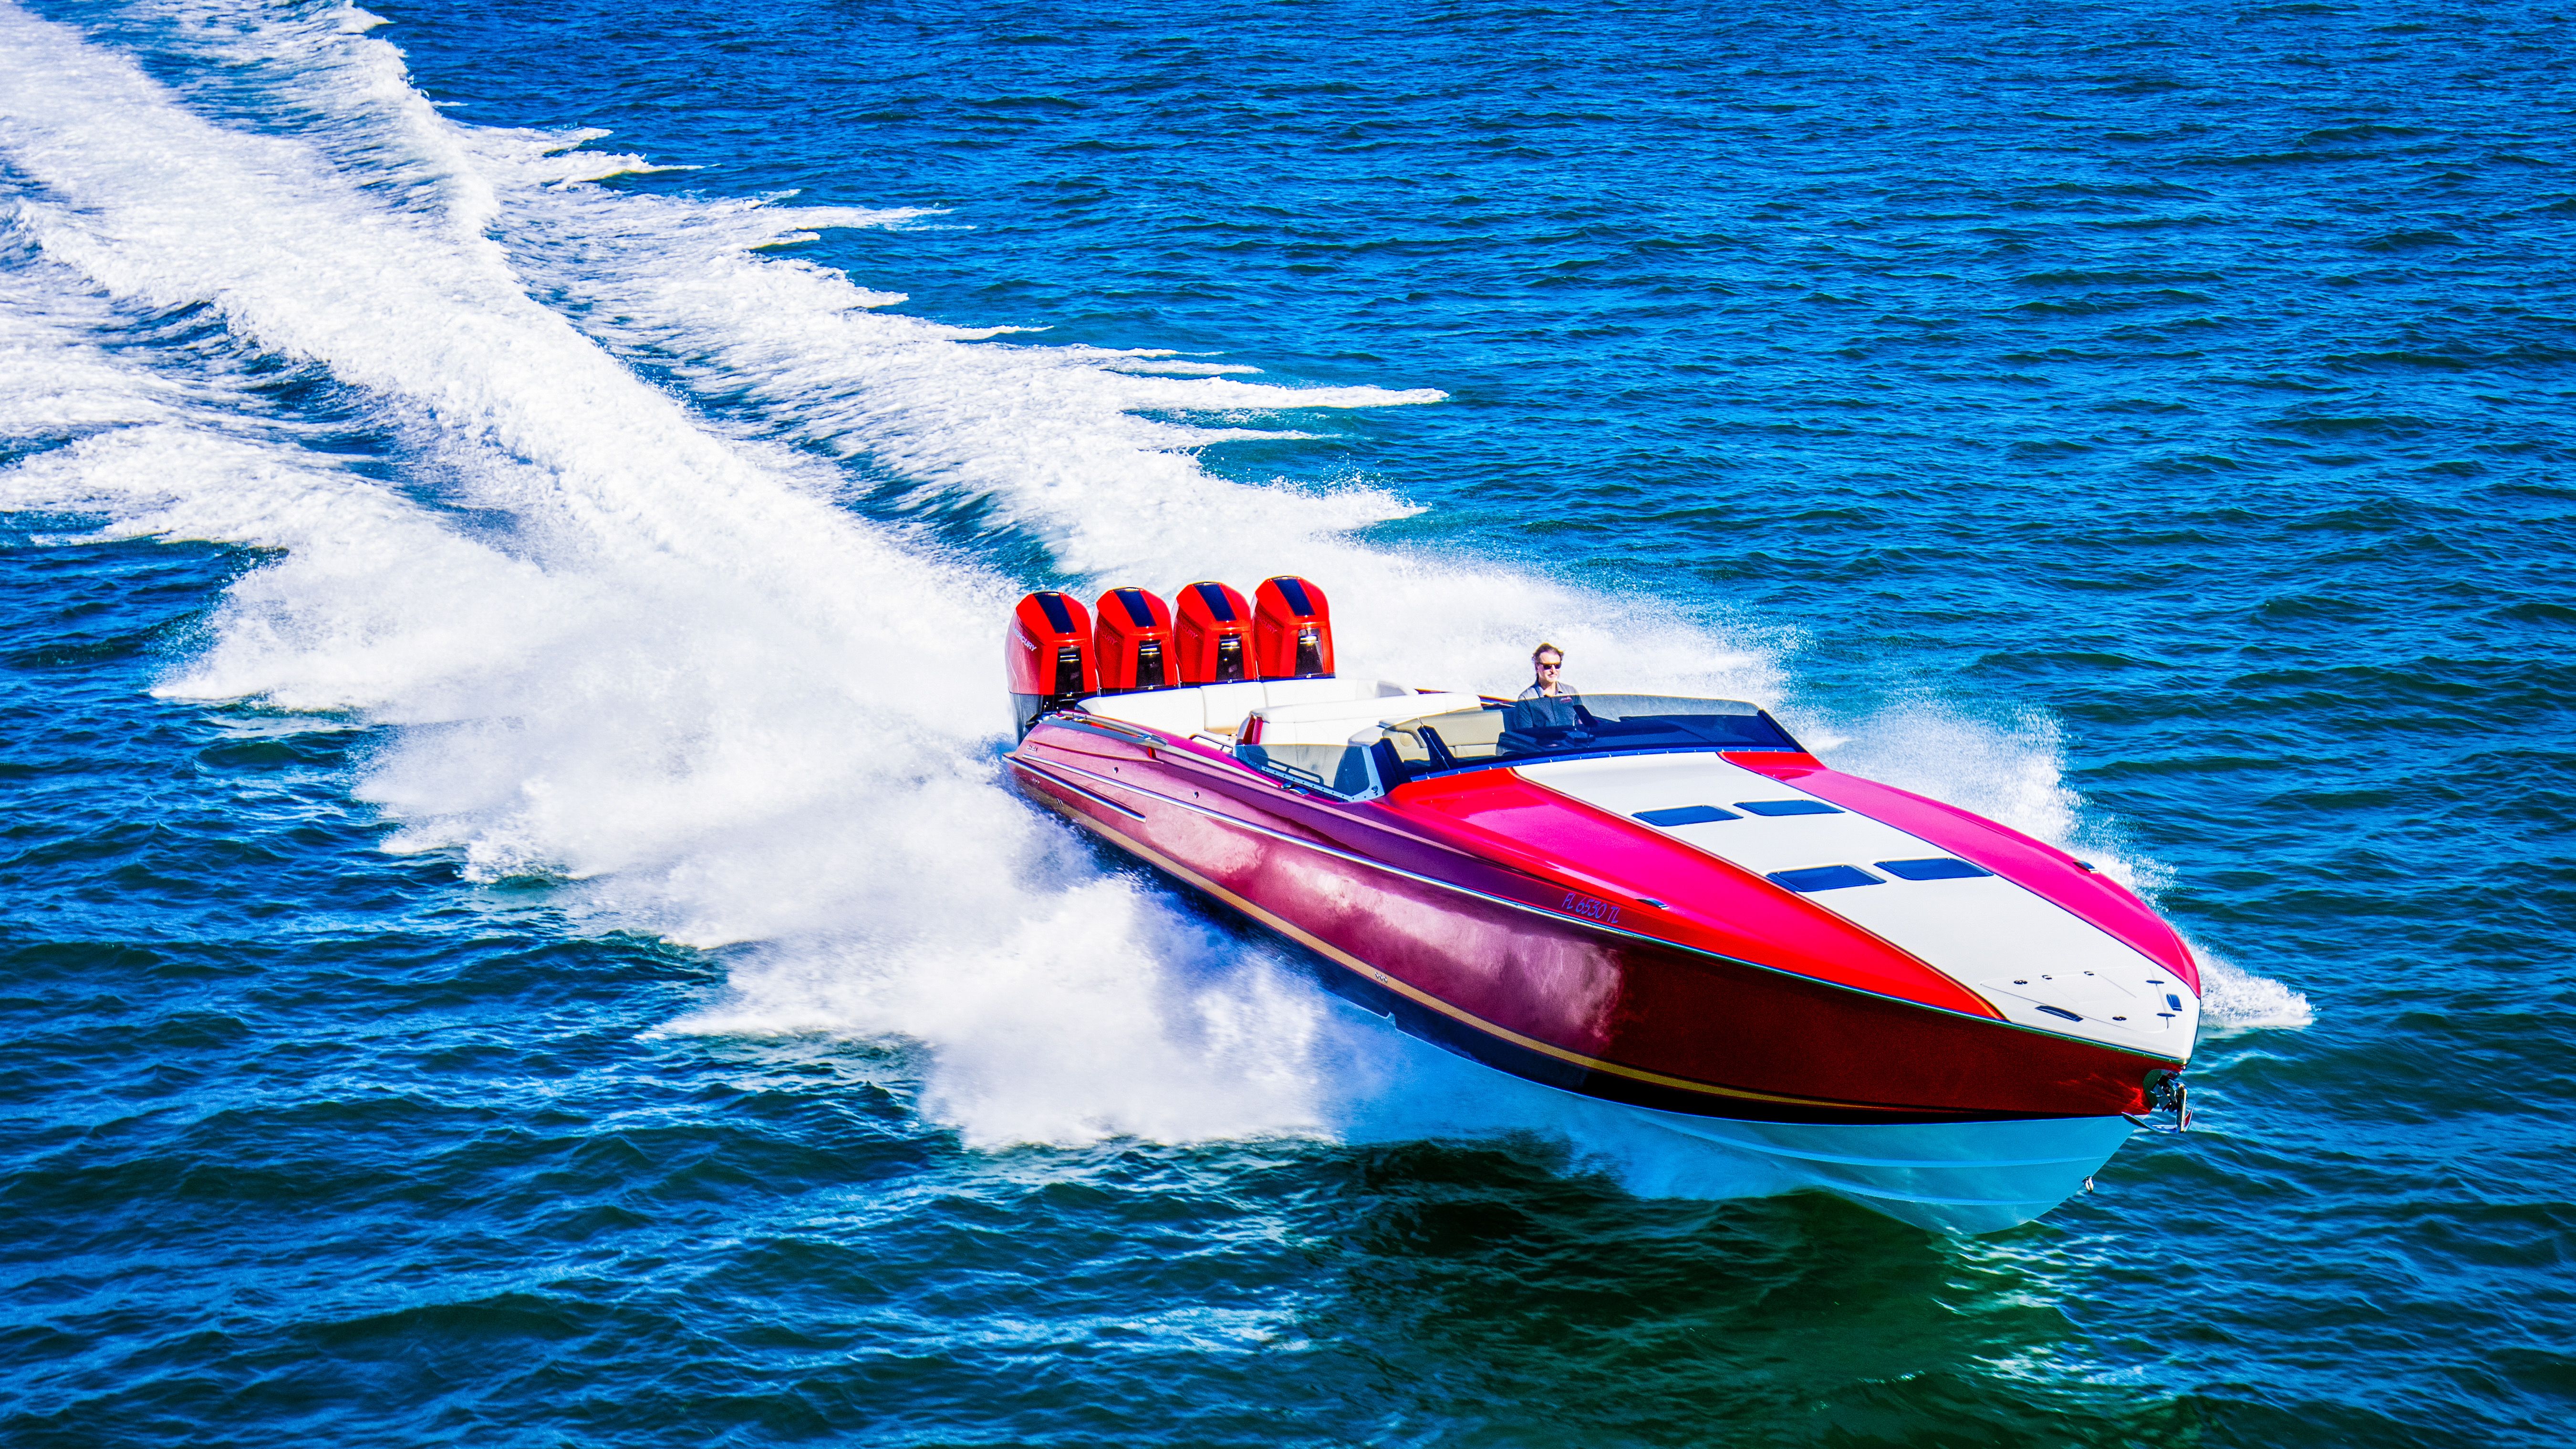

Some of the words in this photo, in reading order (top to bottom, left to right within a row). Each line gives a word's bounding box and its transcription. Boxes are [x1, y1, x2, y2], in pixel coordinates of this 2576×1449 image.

[1013, 626, 1037, 652] MERCURY
[1561, 892, 1576, 909] FL
[1576, 897, 1607, 919] 6530
[1607, 906, 1621, 924] TL
